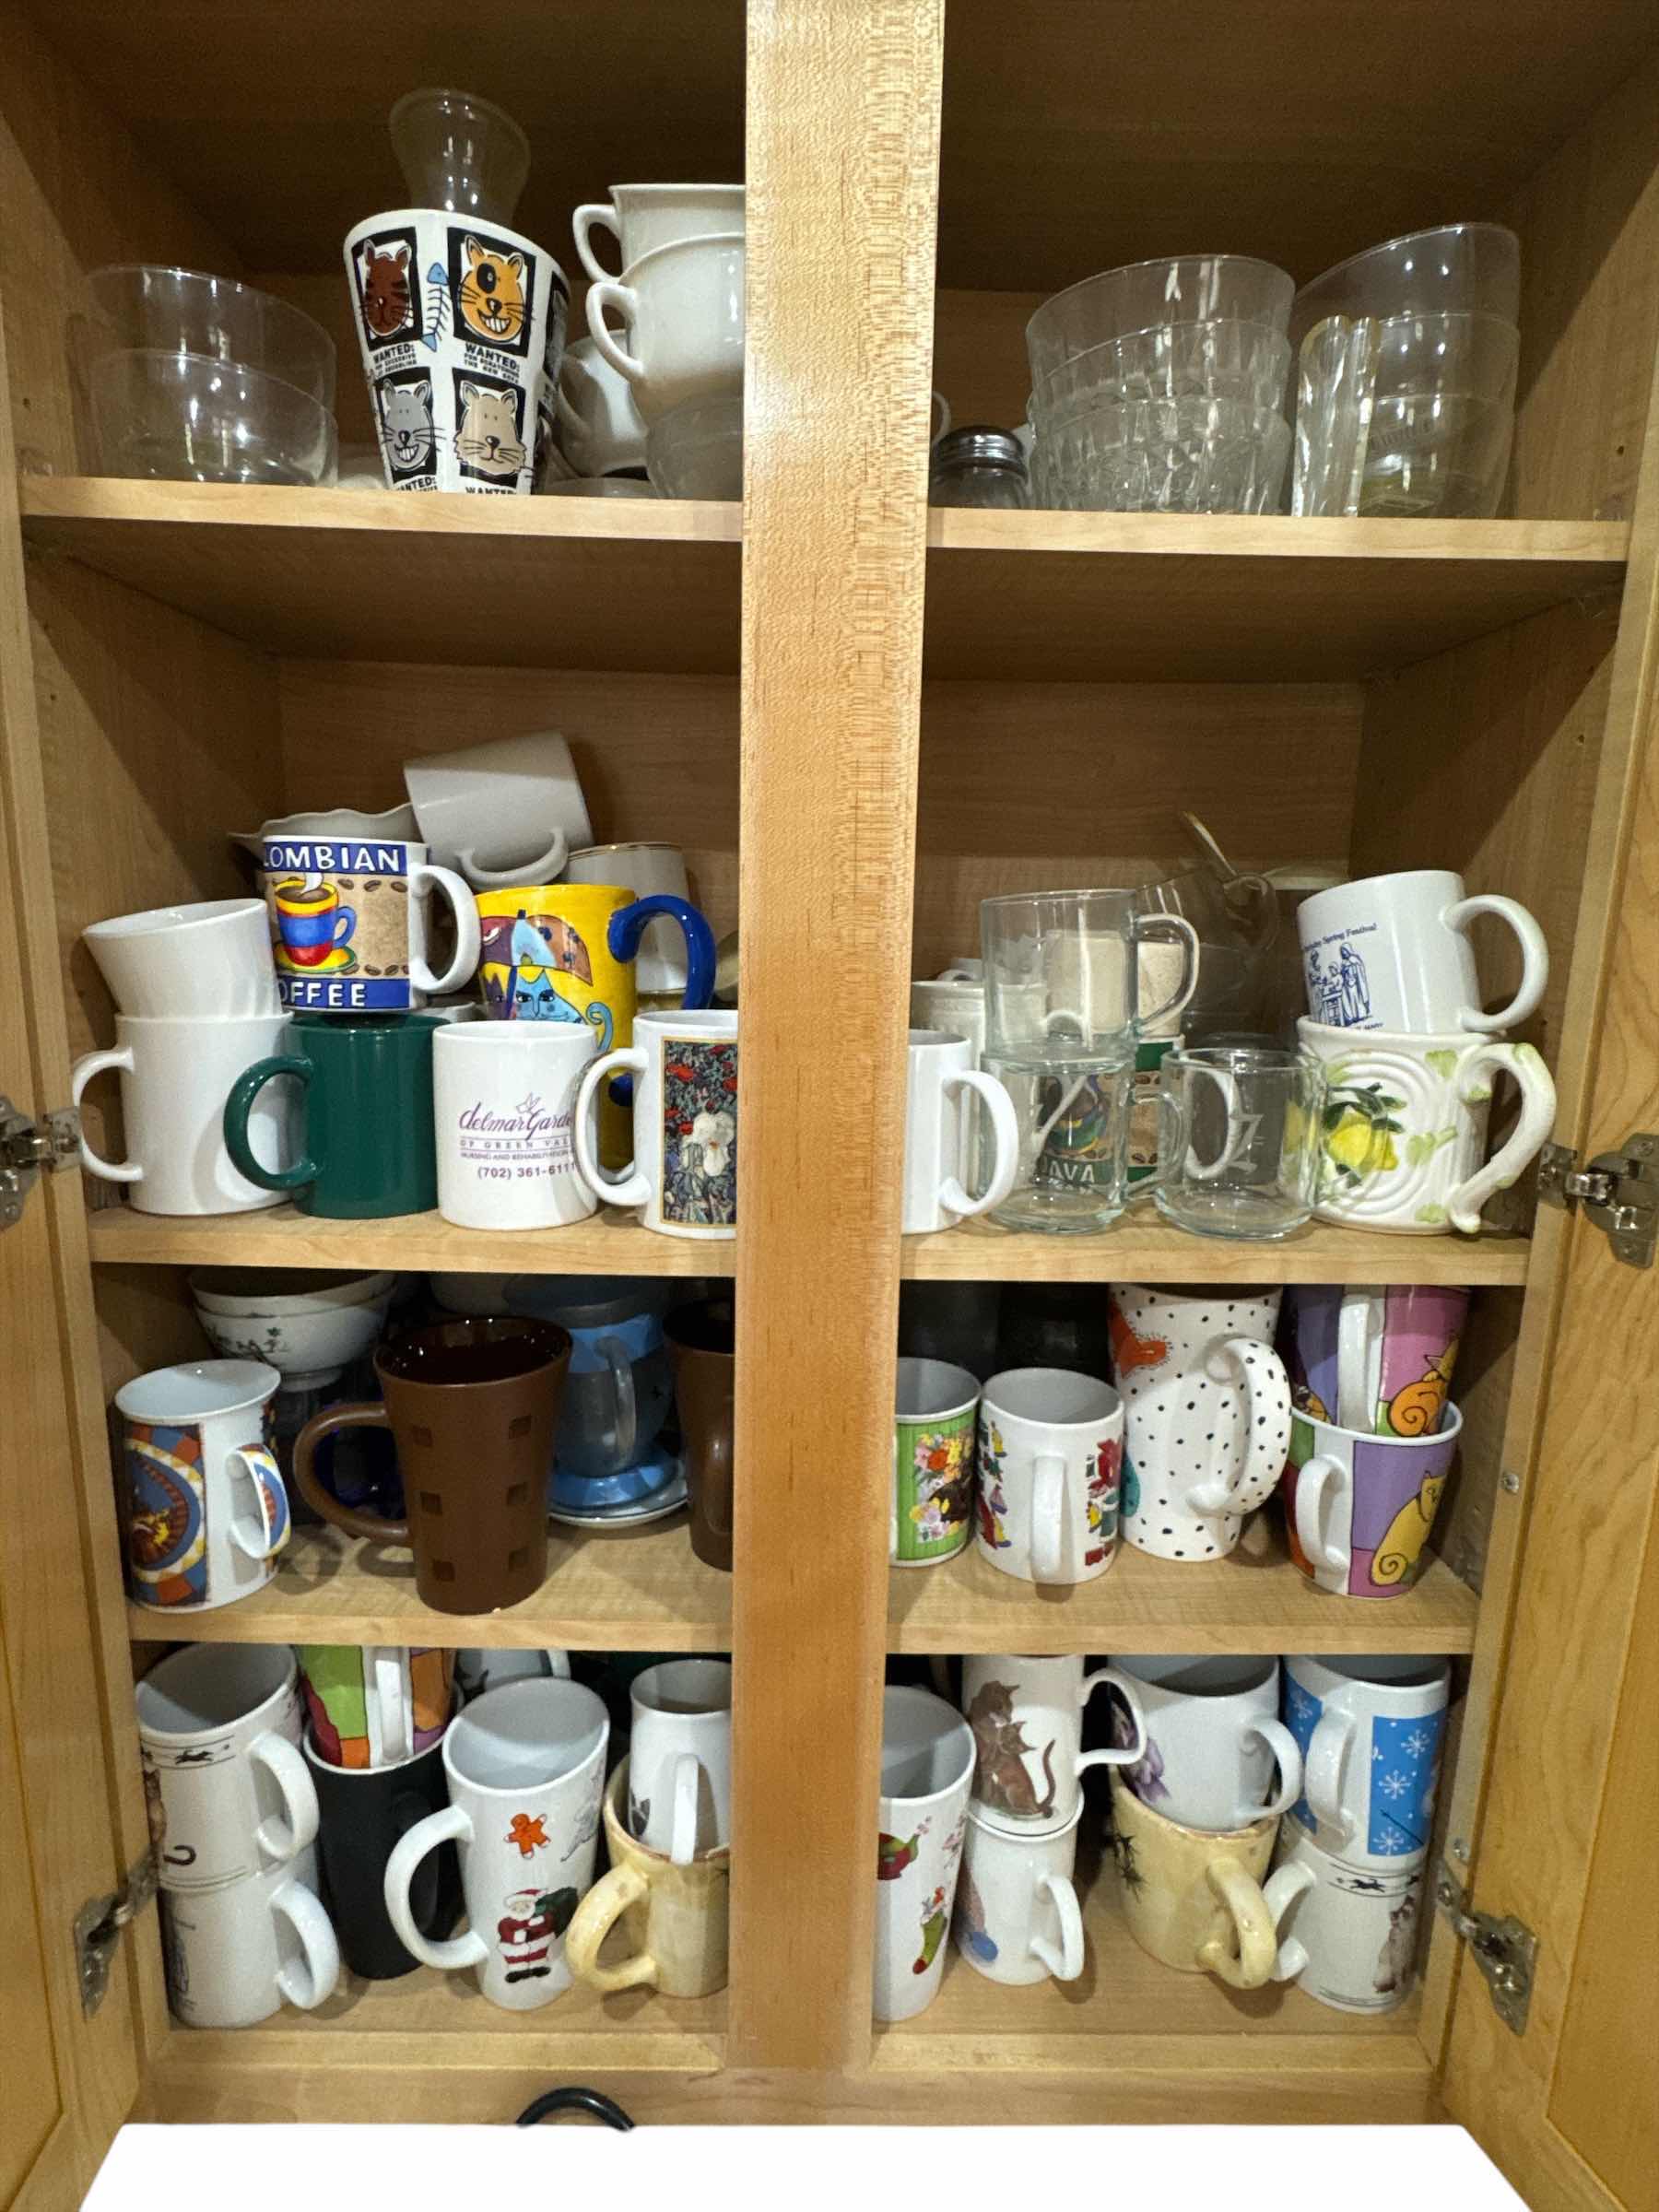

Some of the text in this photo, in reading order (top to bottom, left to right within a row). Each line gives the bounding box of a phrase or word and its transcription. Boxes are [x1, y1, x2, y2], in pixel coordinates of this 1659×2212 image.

[373, 343, 414, 363] WANTED:
[465, 342, 520, 372] WANTED:
[397, 477, 437, 491] ANTED:
[264, 845, 400, 873] OMBIAN
[477, 1166, 512, 1181] (702)
